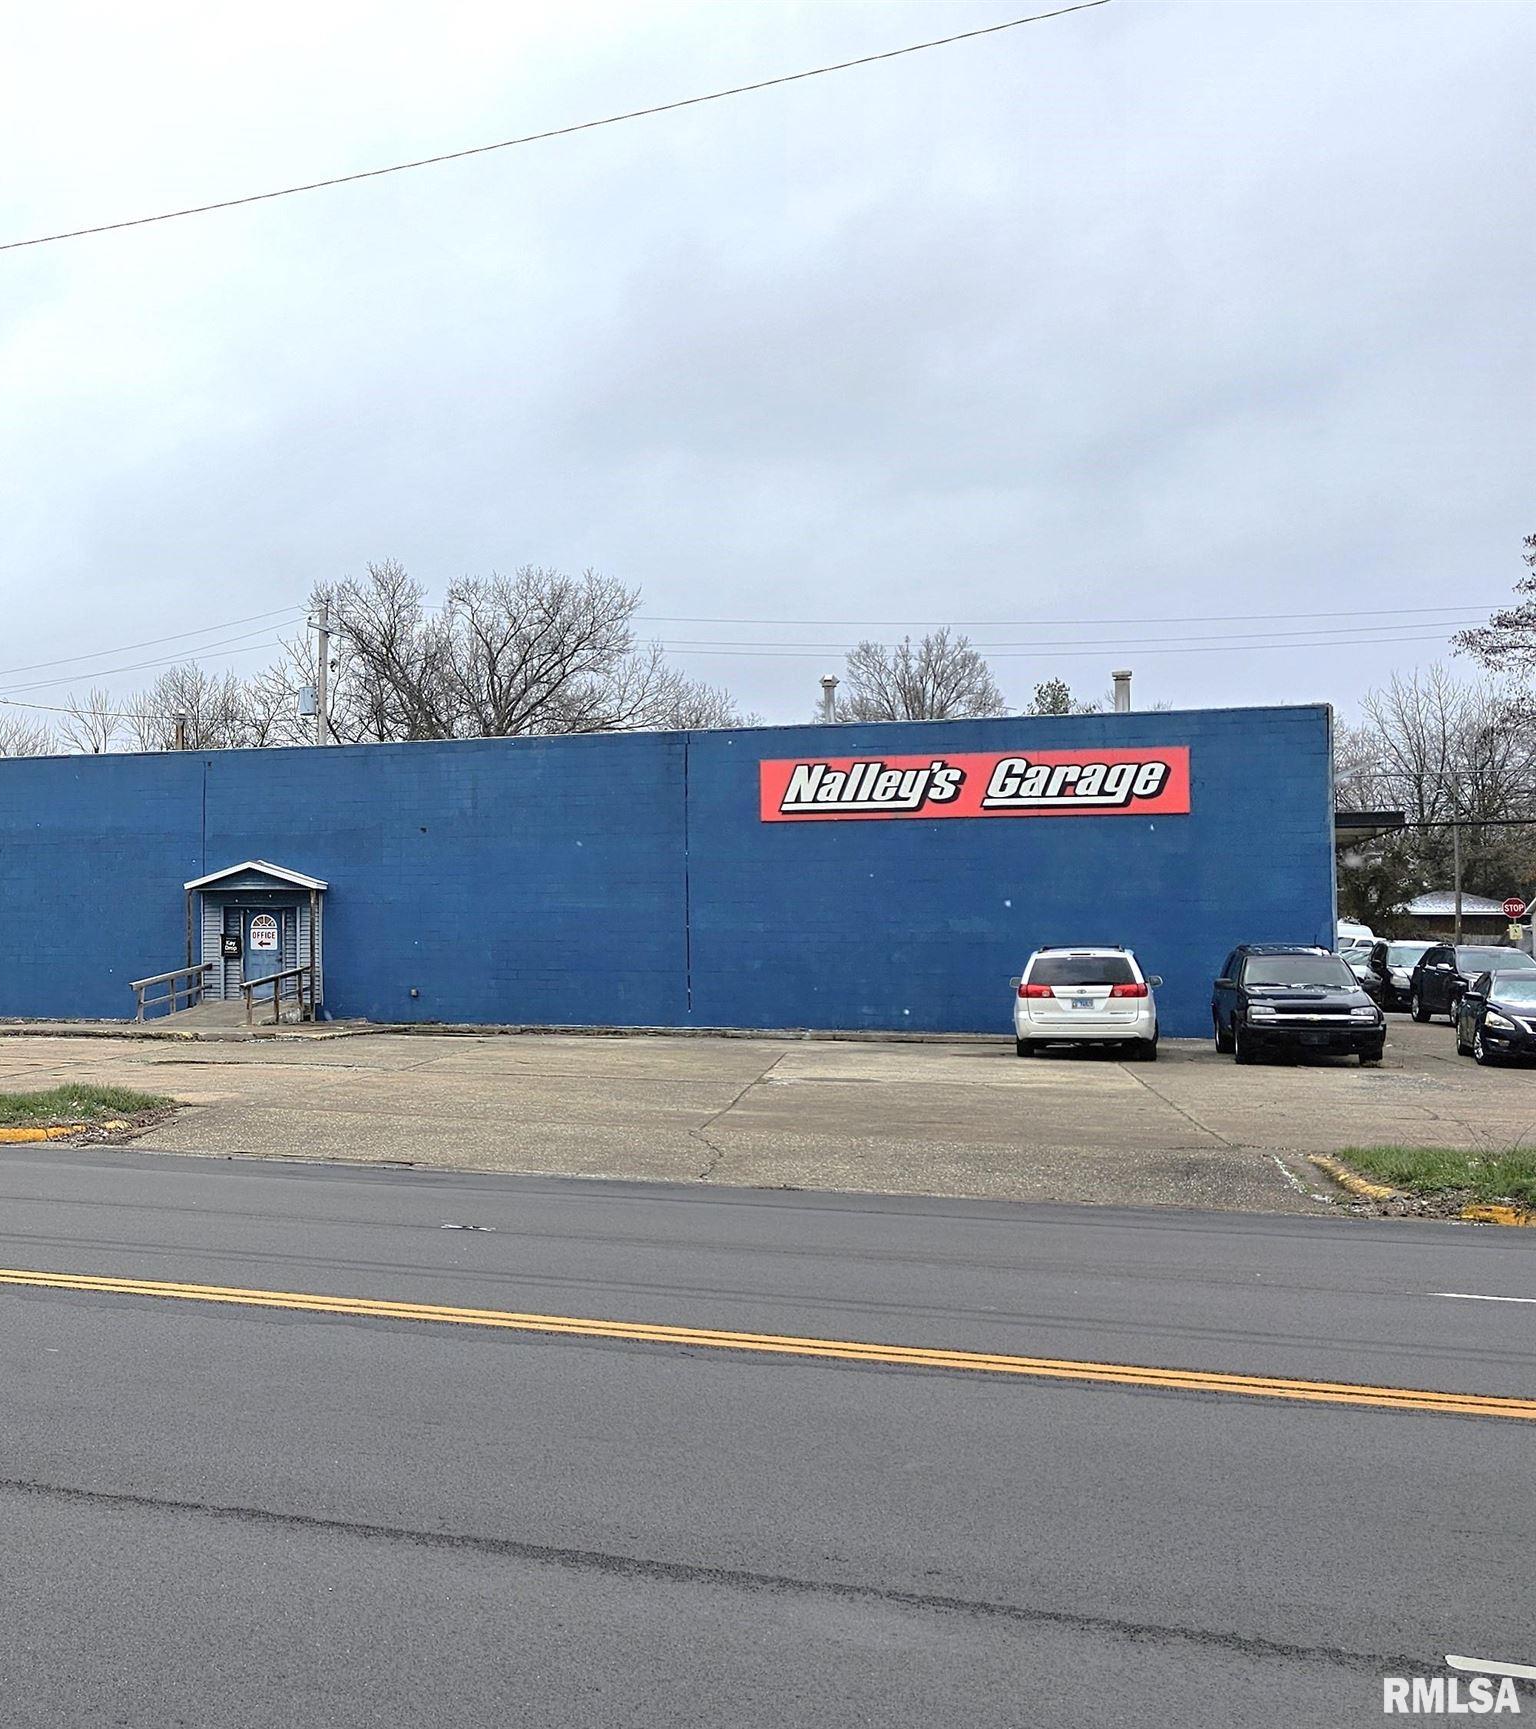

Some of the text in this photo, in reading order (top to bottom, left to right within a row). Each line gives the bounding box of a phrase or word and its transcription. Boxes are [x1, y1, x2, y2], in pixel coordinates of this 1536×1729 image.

[782, 758, 1170, 811] Nalley's Garage
[1504, 904, 1524, 912] STOP
[253, 931, 275, 939] OFFICE
